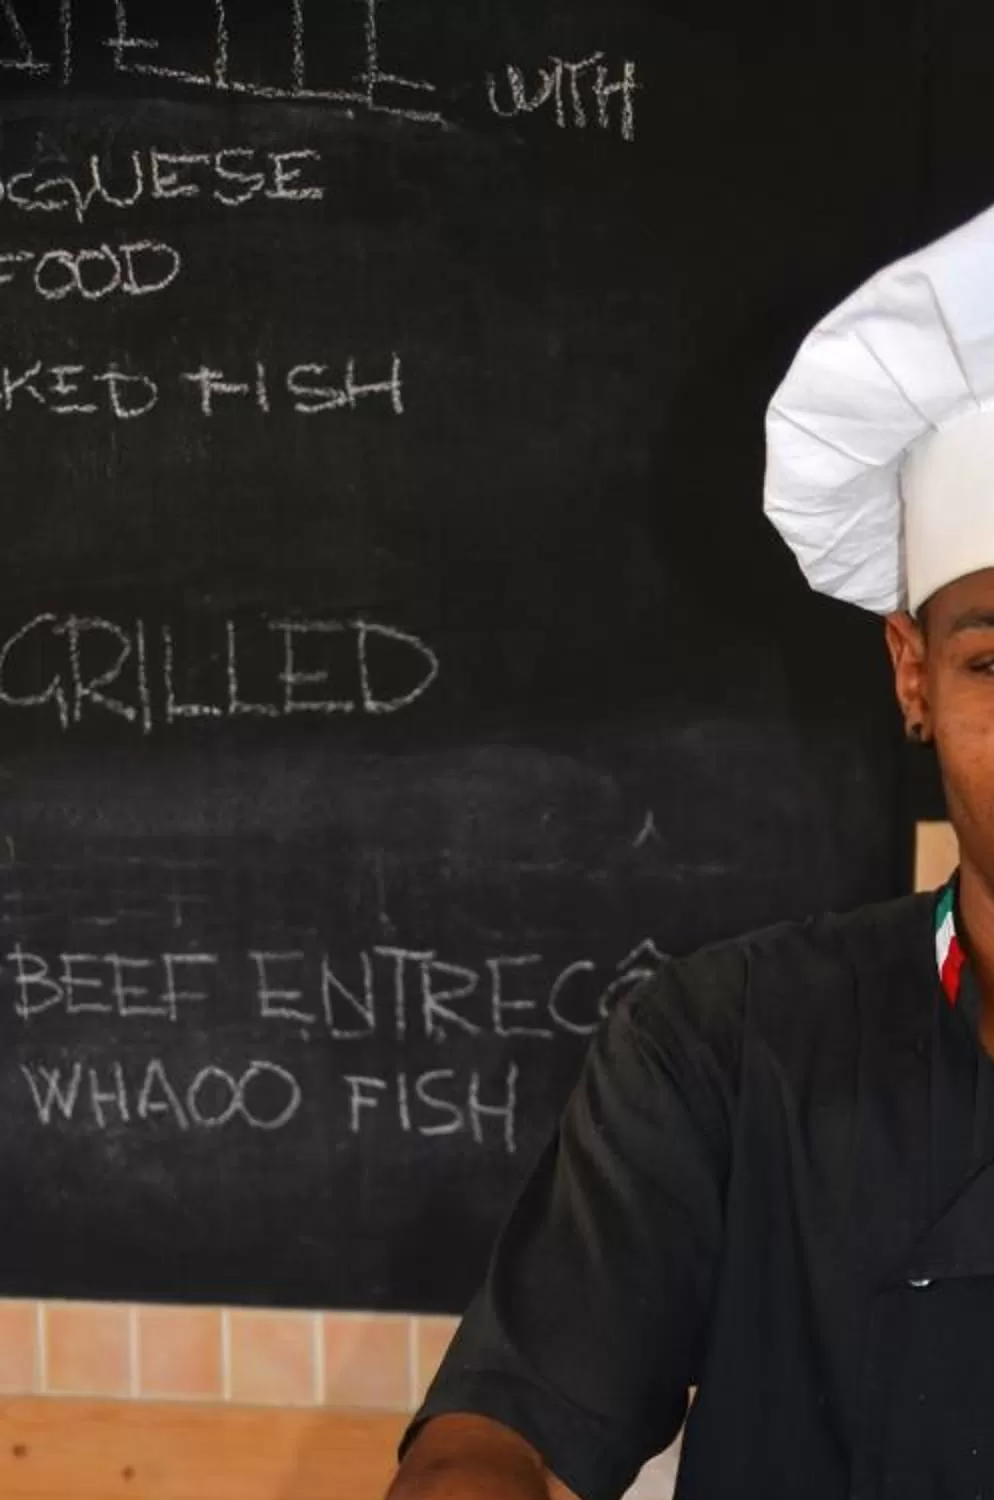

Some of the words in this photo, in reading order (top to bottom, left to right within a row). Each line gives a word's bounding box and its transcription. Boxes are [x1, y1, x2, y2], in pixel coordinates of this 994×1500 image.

[486, 51, 637, 141] WITH
[0, 148, 323, 222] GUESE
[0, 361, 158, 417] KED
[183, 353, 405, 416] FISH
[0, 613, 438, 733] GRILLED
[6, 943, 218, 1020] BEEF
[20, 1059, 300, 1130] WHAOO
[345, 1062, 518, 1152] FISH
